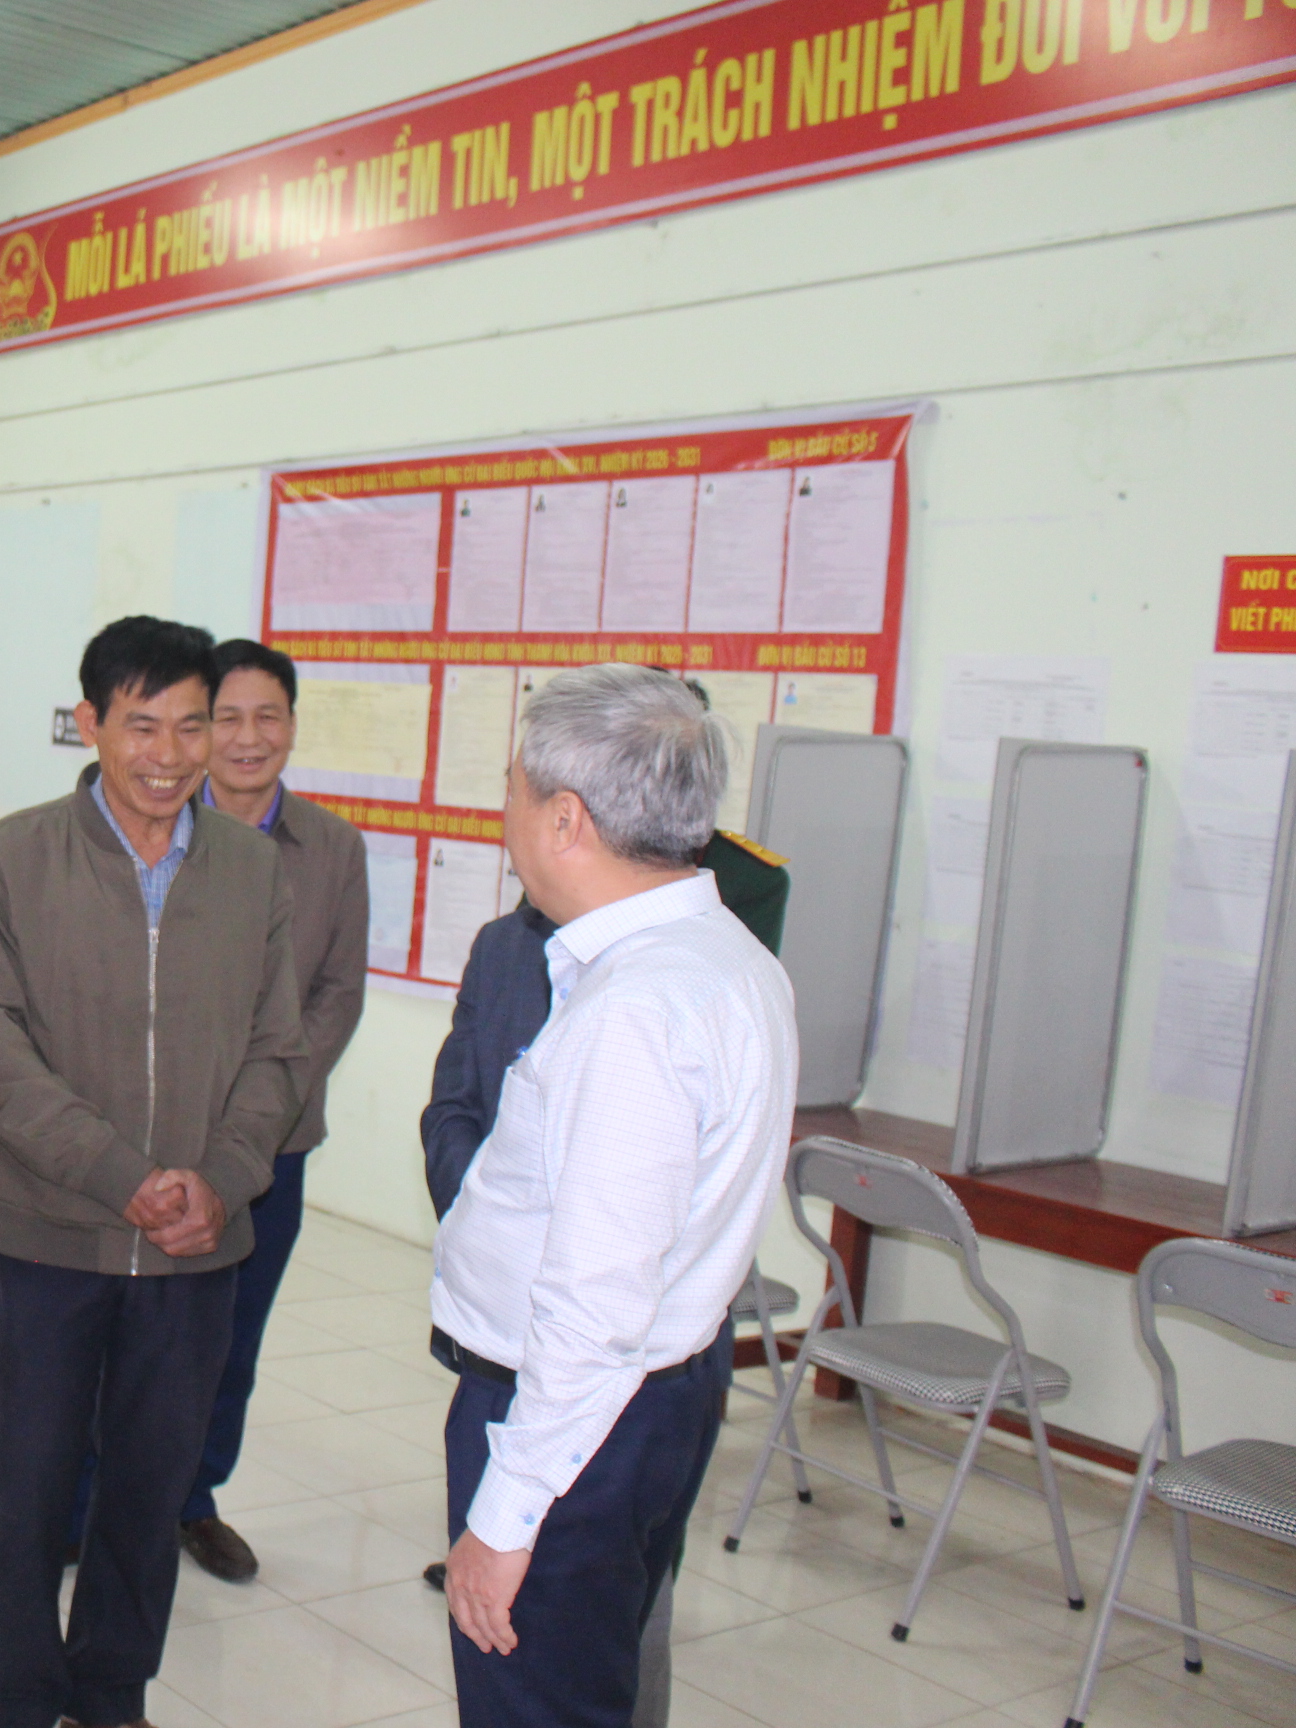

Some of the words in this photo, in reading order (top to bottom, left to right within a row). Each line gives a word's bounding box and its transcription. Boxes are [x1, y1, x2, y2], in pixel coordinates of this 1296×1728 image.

[65, 211, 113, 302] MỖI
[115, 207, 147, 290] LÁ
[151, 180, 232, 281] PHIẾU
[236, 173, 271, 261] LÀ
[278, 156, 348, 260] MỘT
[353, 124, 442, 233] NIỀM
[451, 121, 519, 208] TIN,
[530, 81, 620, 201] MỘT
[630, 47, 776, 169] TRÁCH
[786, 0, 965, 131] NHIỆM
[1240, 567, 1280, 590] NƠI
[1230, 599, 1266, 631] VIẾT
